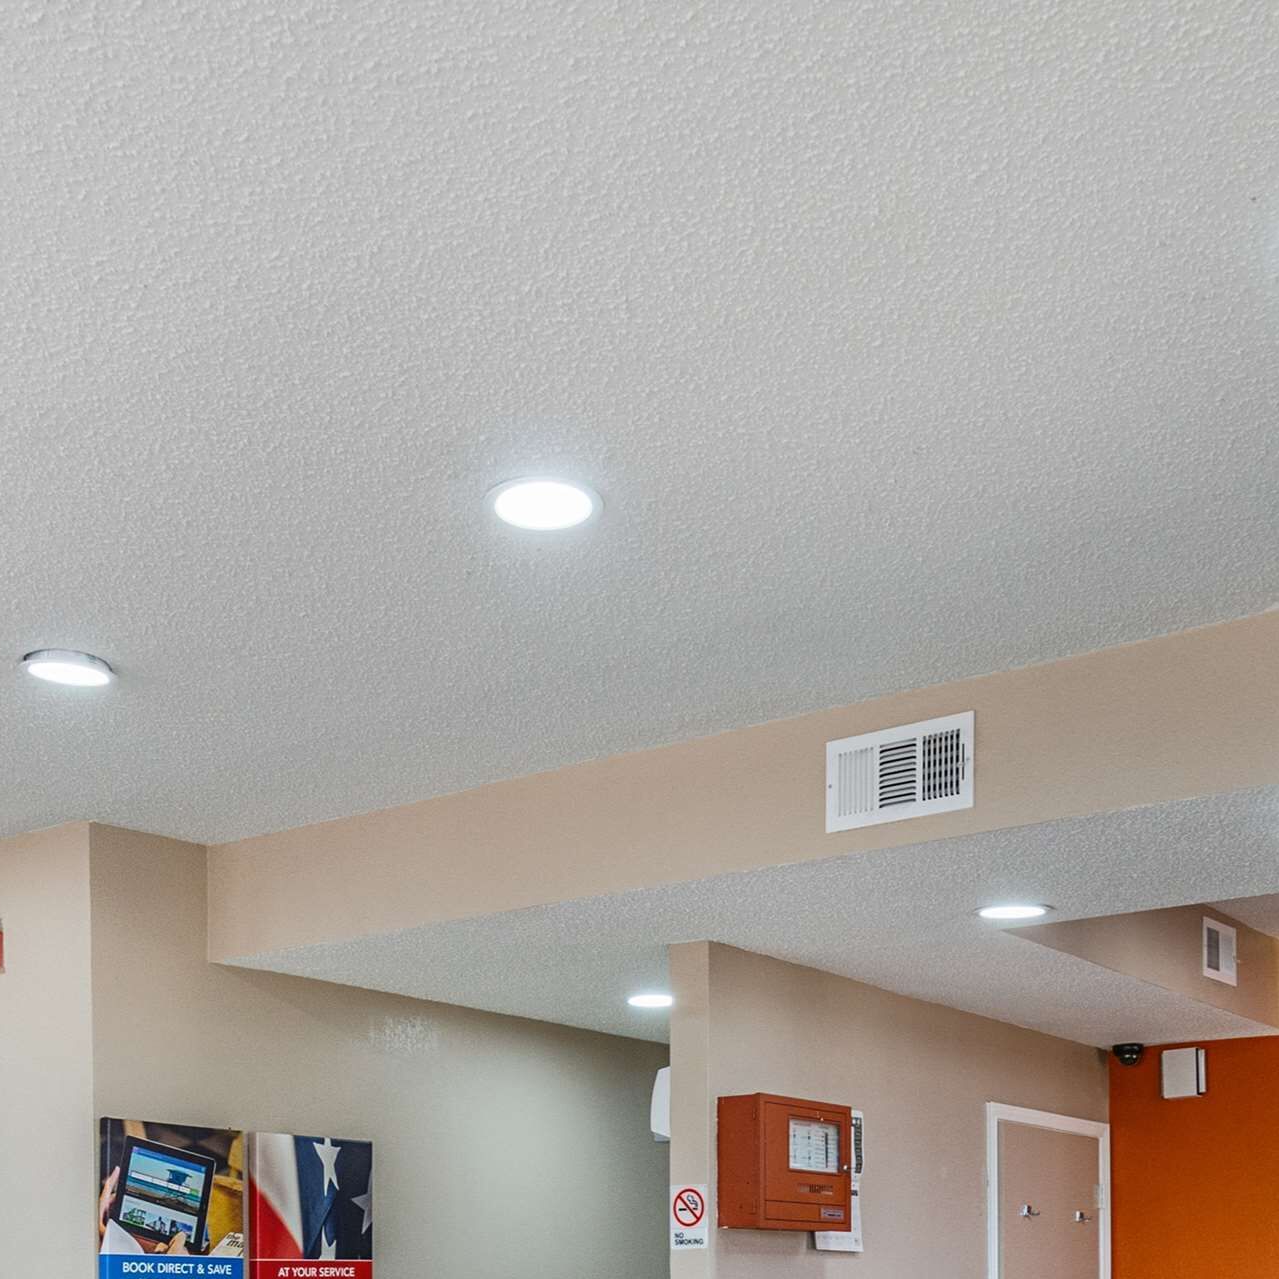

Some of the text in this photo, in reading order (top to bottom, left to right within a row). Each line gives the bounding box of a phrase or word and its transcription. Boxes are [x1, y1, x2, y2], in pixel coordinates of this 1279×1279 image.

[674, 1238, 704, 1246] SMOKING
[122, 1262, 232, 1275] BOOK DIRECT & SAVE
[278, 1267, 355, 1277] AT YOUR SERVICE
